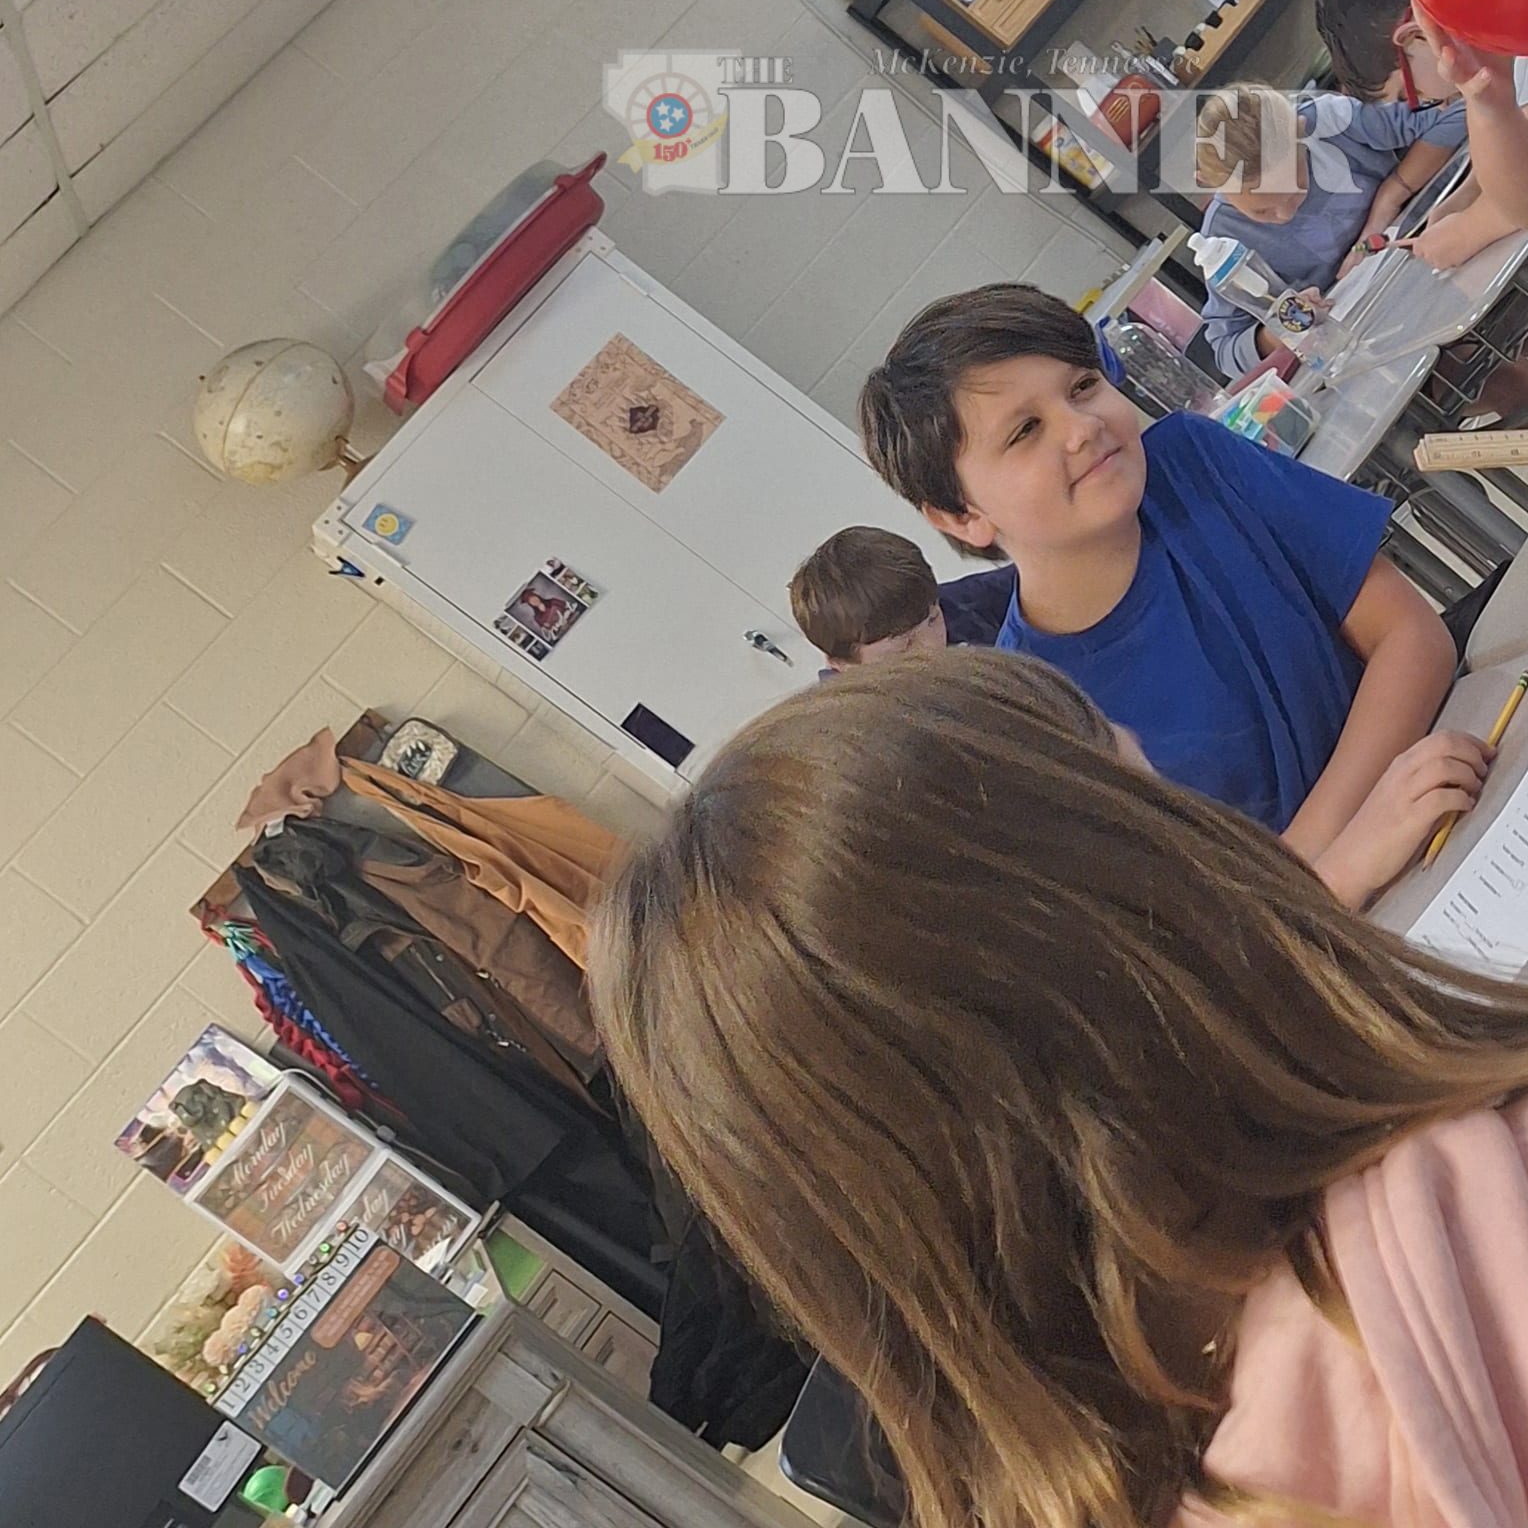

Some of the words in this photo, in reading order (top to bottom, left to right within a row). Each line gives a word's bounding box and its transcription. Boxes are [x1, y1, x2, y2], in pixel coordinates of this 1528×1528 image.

[230, 1123, 286, 1186] Monday
[260, 1143, 314, 1213] Tuesday
[271, 1154, 351, 1242] Wednesday
[221, 1396, 235, 1410] 1
[236, 1378, 250, 1393] 2
[250, 1359, 264, 1373] 3
[265, 1343, 280, 1356] 4
[280, 1327, 293, 1341] 5
[294, 1308, 308, 1321] 6
[307, 1289, 322, 1303] 7
[322, 1273, 336, 1286] 8
[336, 1254, 349, 1268] 9
[349, 1229, 368, 1251] 10
[249, 1351, 317, 1430] Welcome
